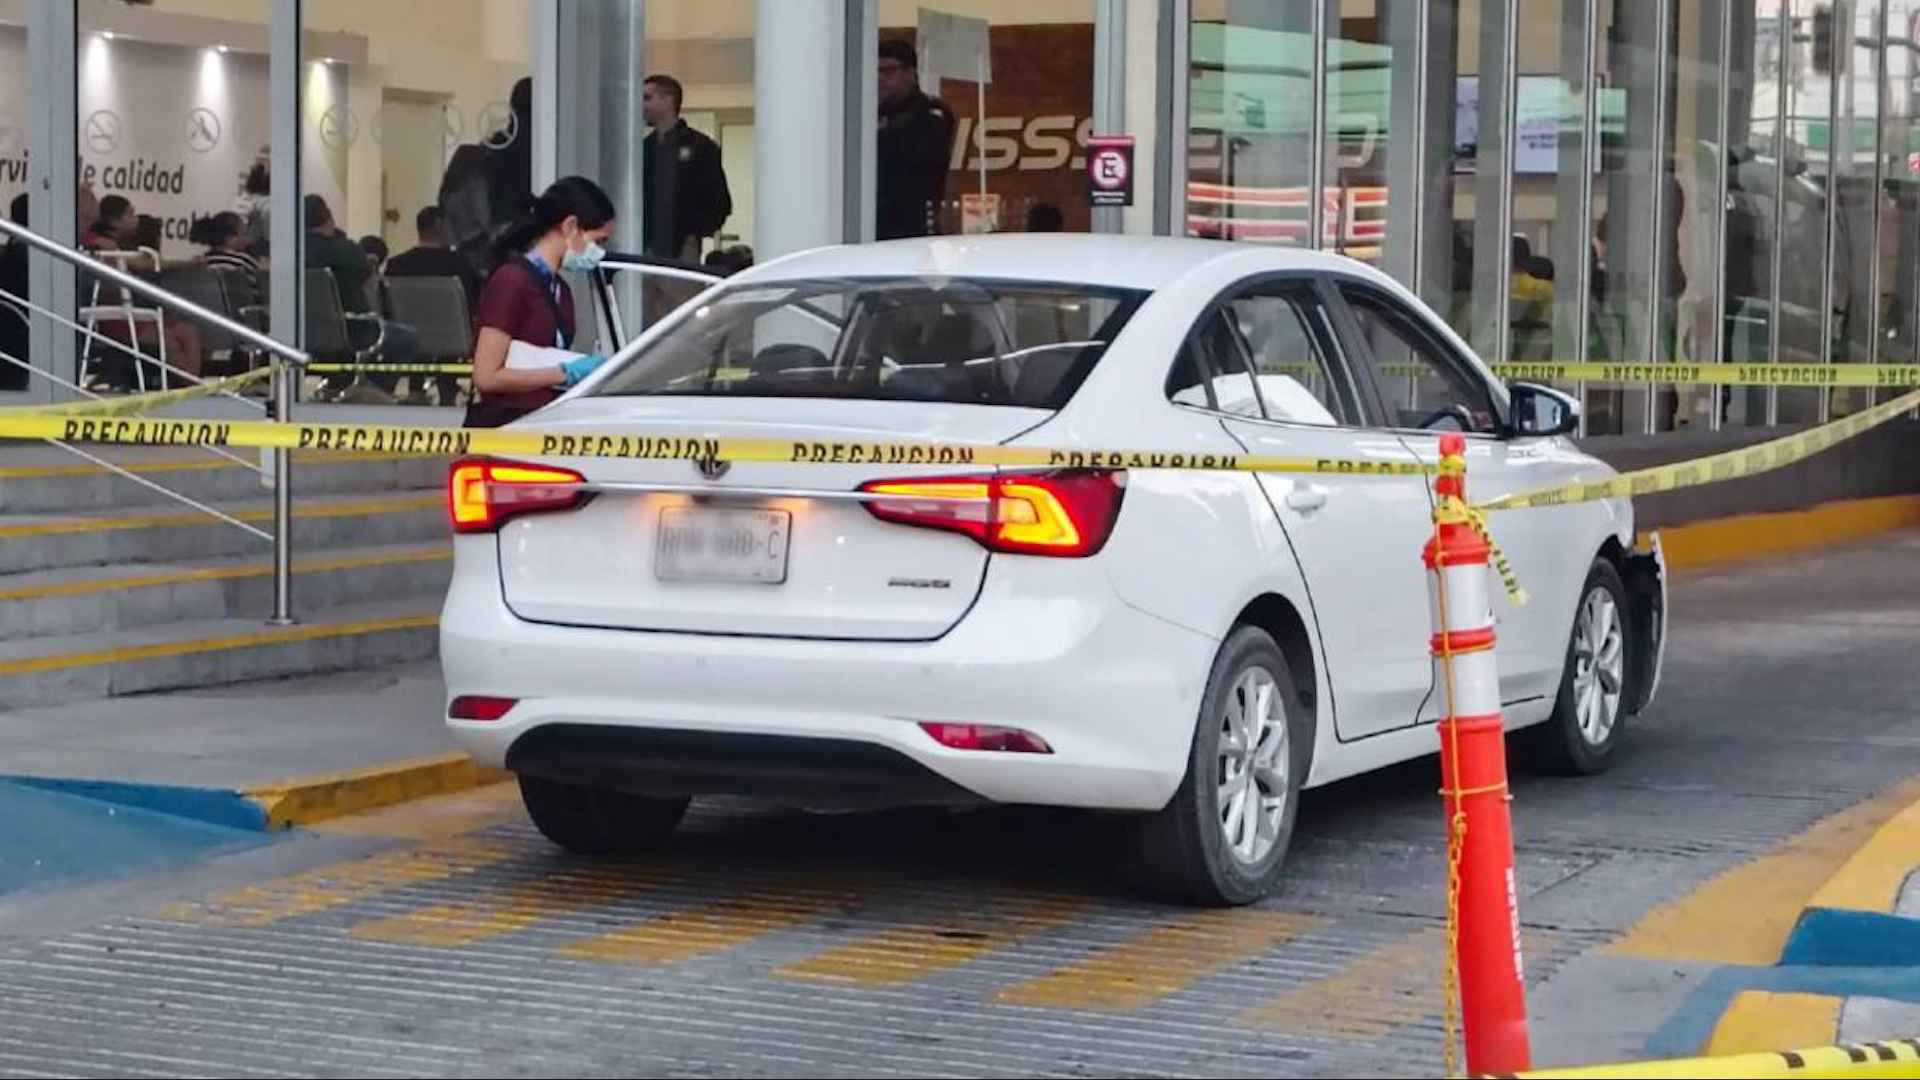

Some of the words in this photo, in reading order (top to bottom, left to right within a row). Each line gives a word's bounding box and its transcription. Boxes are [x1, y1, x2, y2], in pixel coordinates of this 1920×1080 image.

[102, 158, 184, 194] calidad
[64, 420, 230, 445] PRECAUCION
[298, 427, 471, 453] PRECAUCION
[541, 435, 718, 459] PRECAUCION
